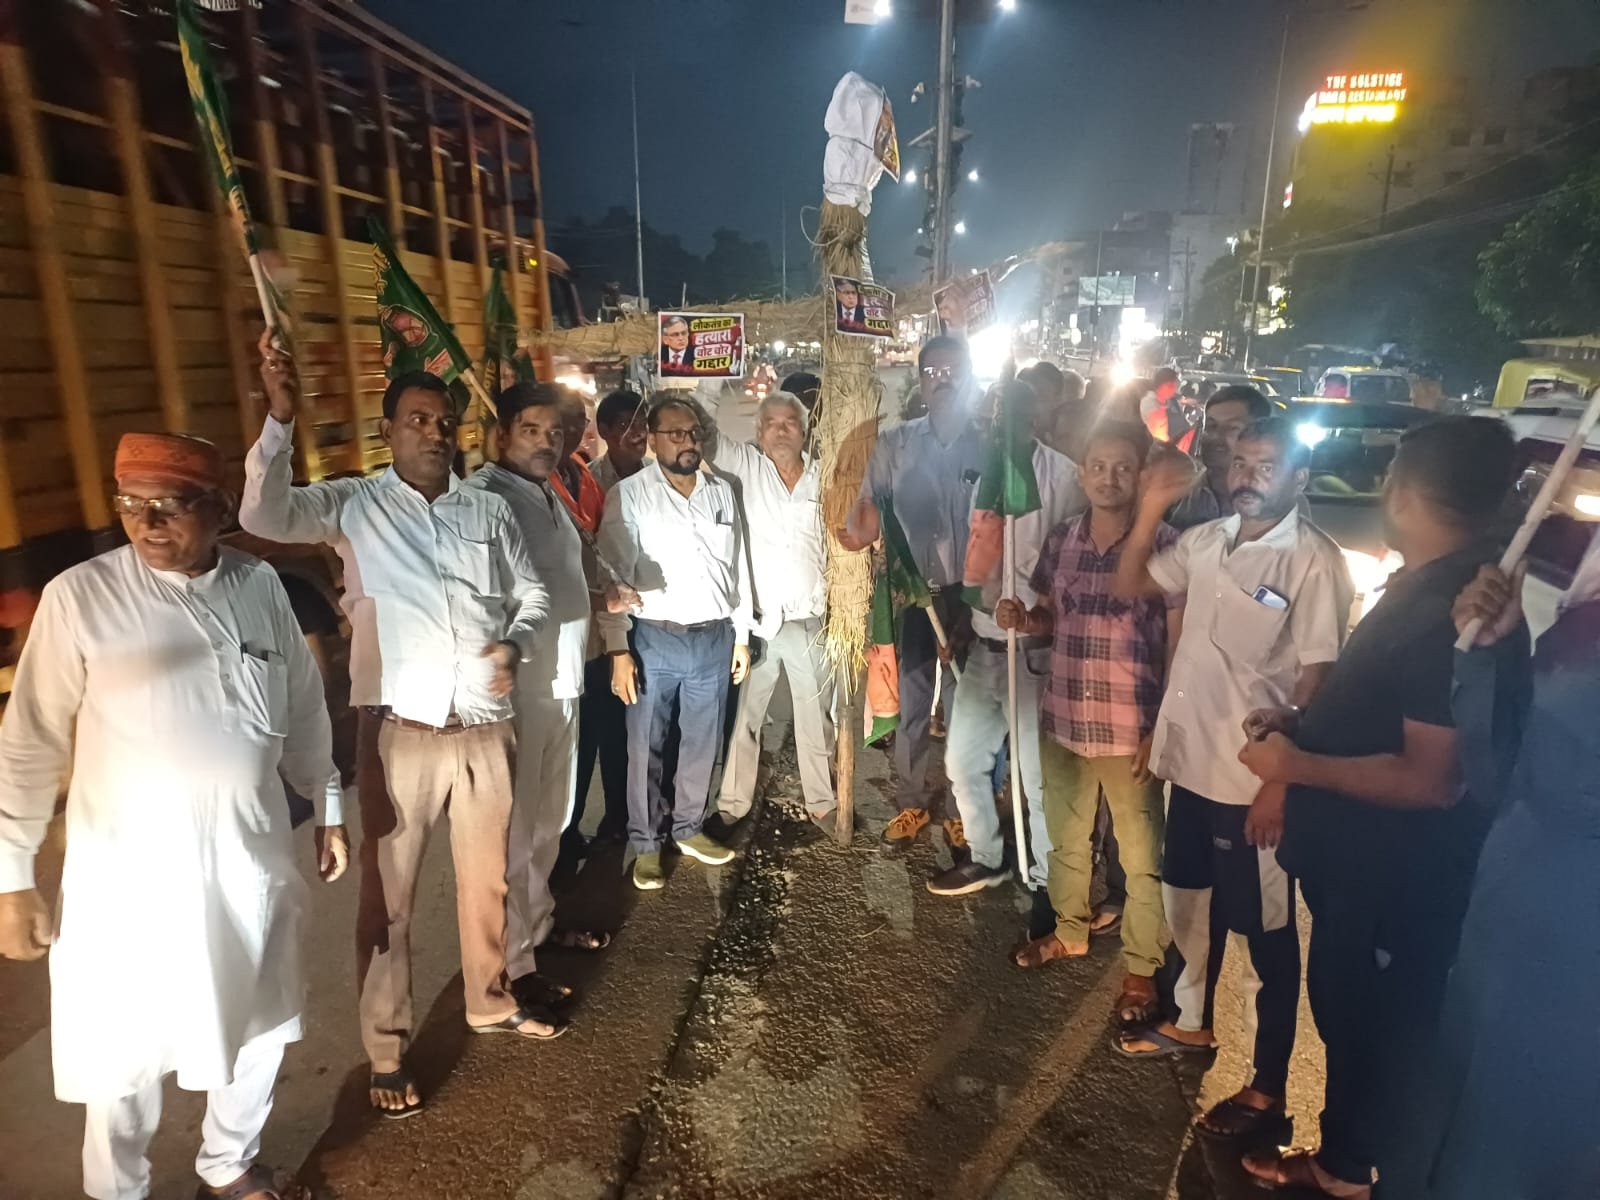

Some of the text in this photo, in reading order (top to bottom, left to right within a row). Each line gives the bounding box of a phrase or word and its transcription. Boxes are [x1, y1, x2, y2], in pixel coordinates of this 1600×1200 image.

[695, 329, 731, 345] हत्यारा
[697, 346, 712, 357] वोट
[696, 357, 727, 369] गद्दार
